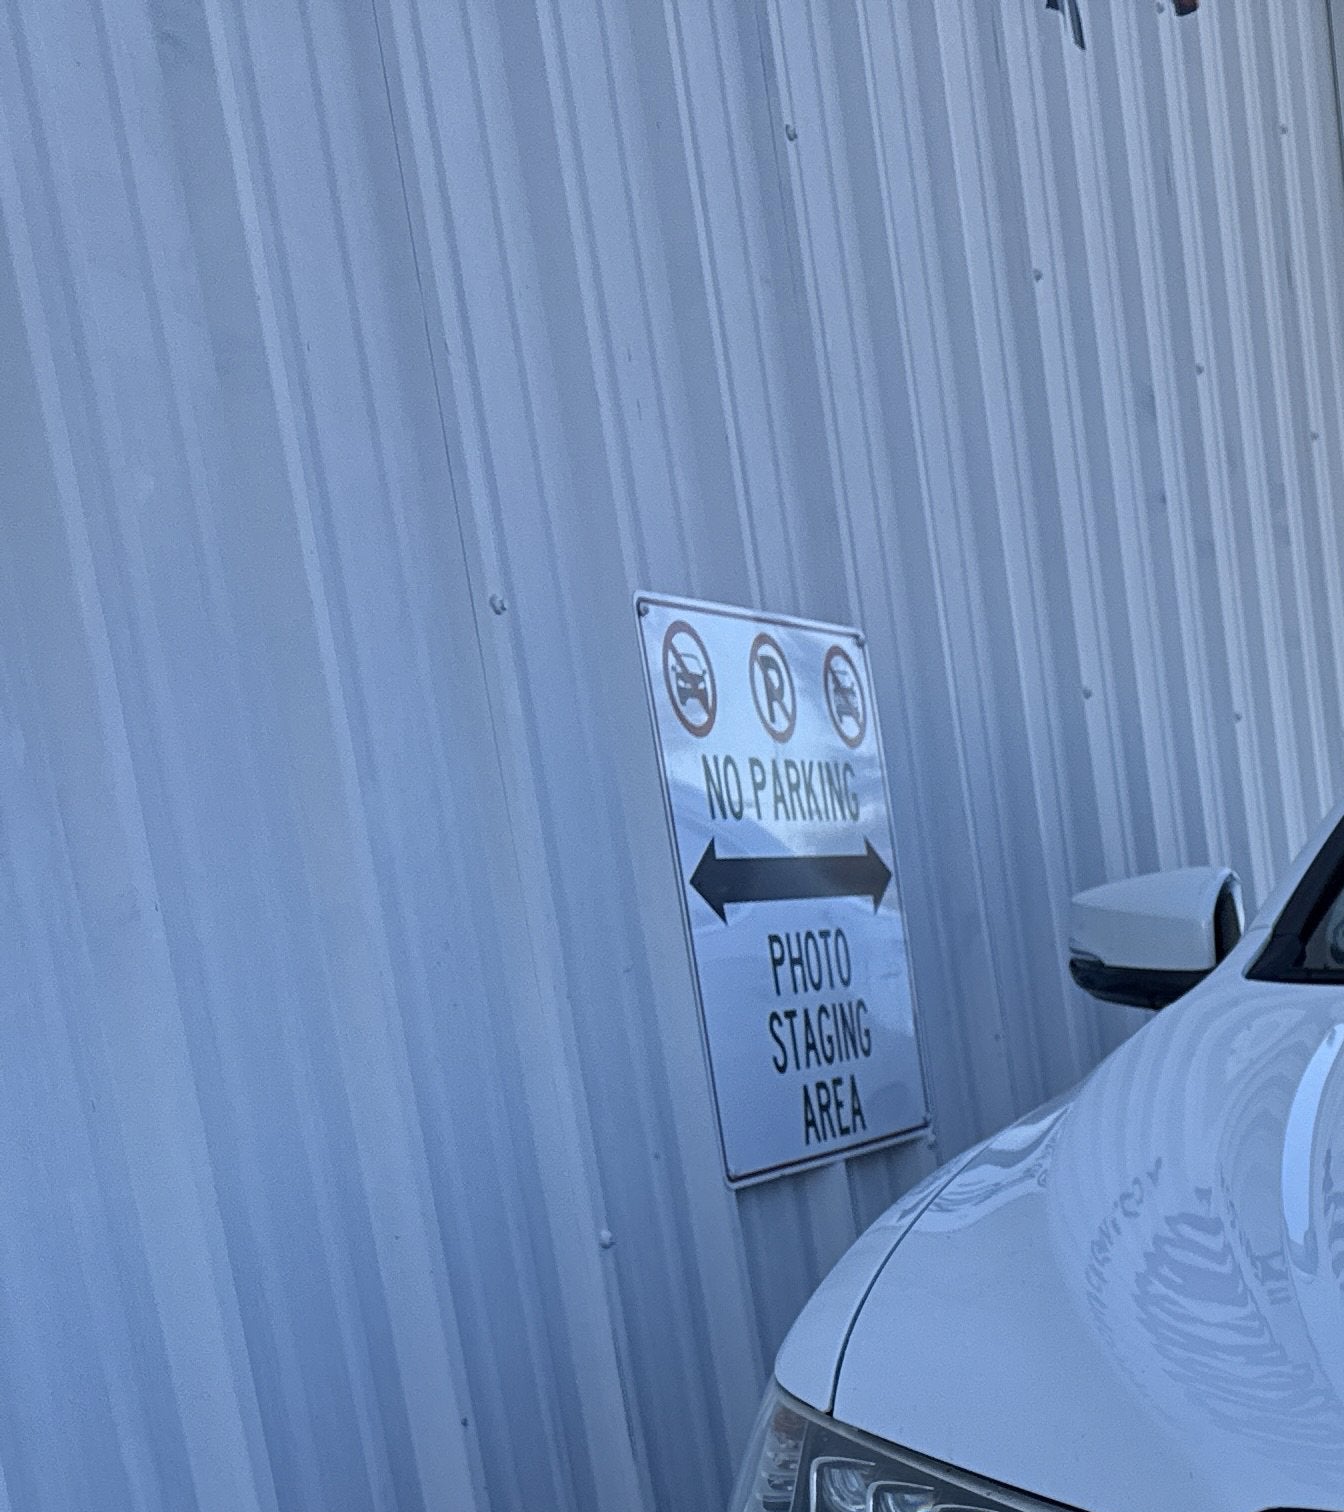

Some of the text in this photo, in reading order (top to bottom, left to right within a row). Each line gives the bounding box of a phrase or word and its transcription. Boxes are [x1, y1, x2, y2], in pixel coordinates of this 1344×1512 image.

[701, 753, 861, 822] NO PARKING
[767, 927, 852, 996] PHOTO
[768, 999, 873, 1075] STAGING
[801, 1073, 868, 1146] AREA
